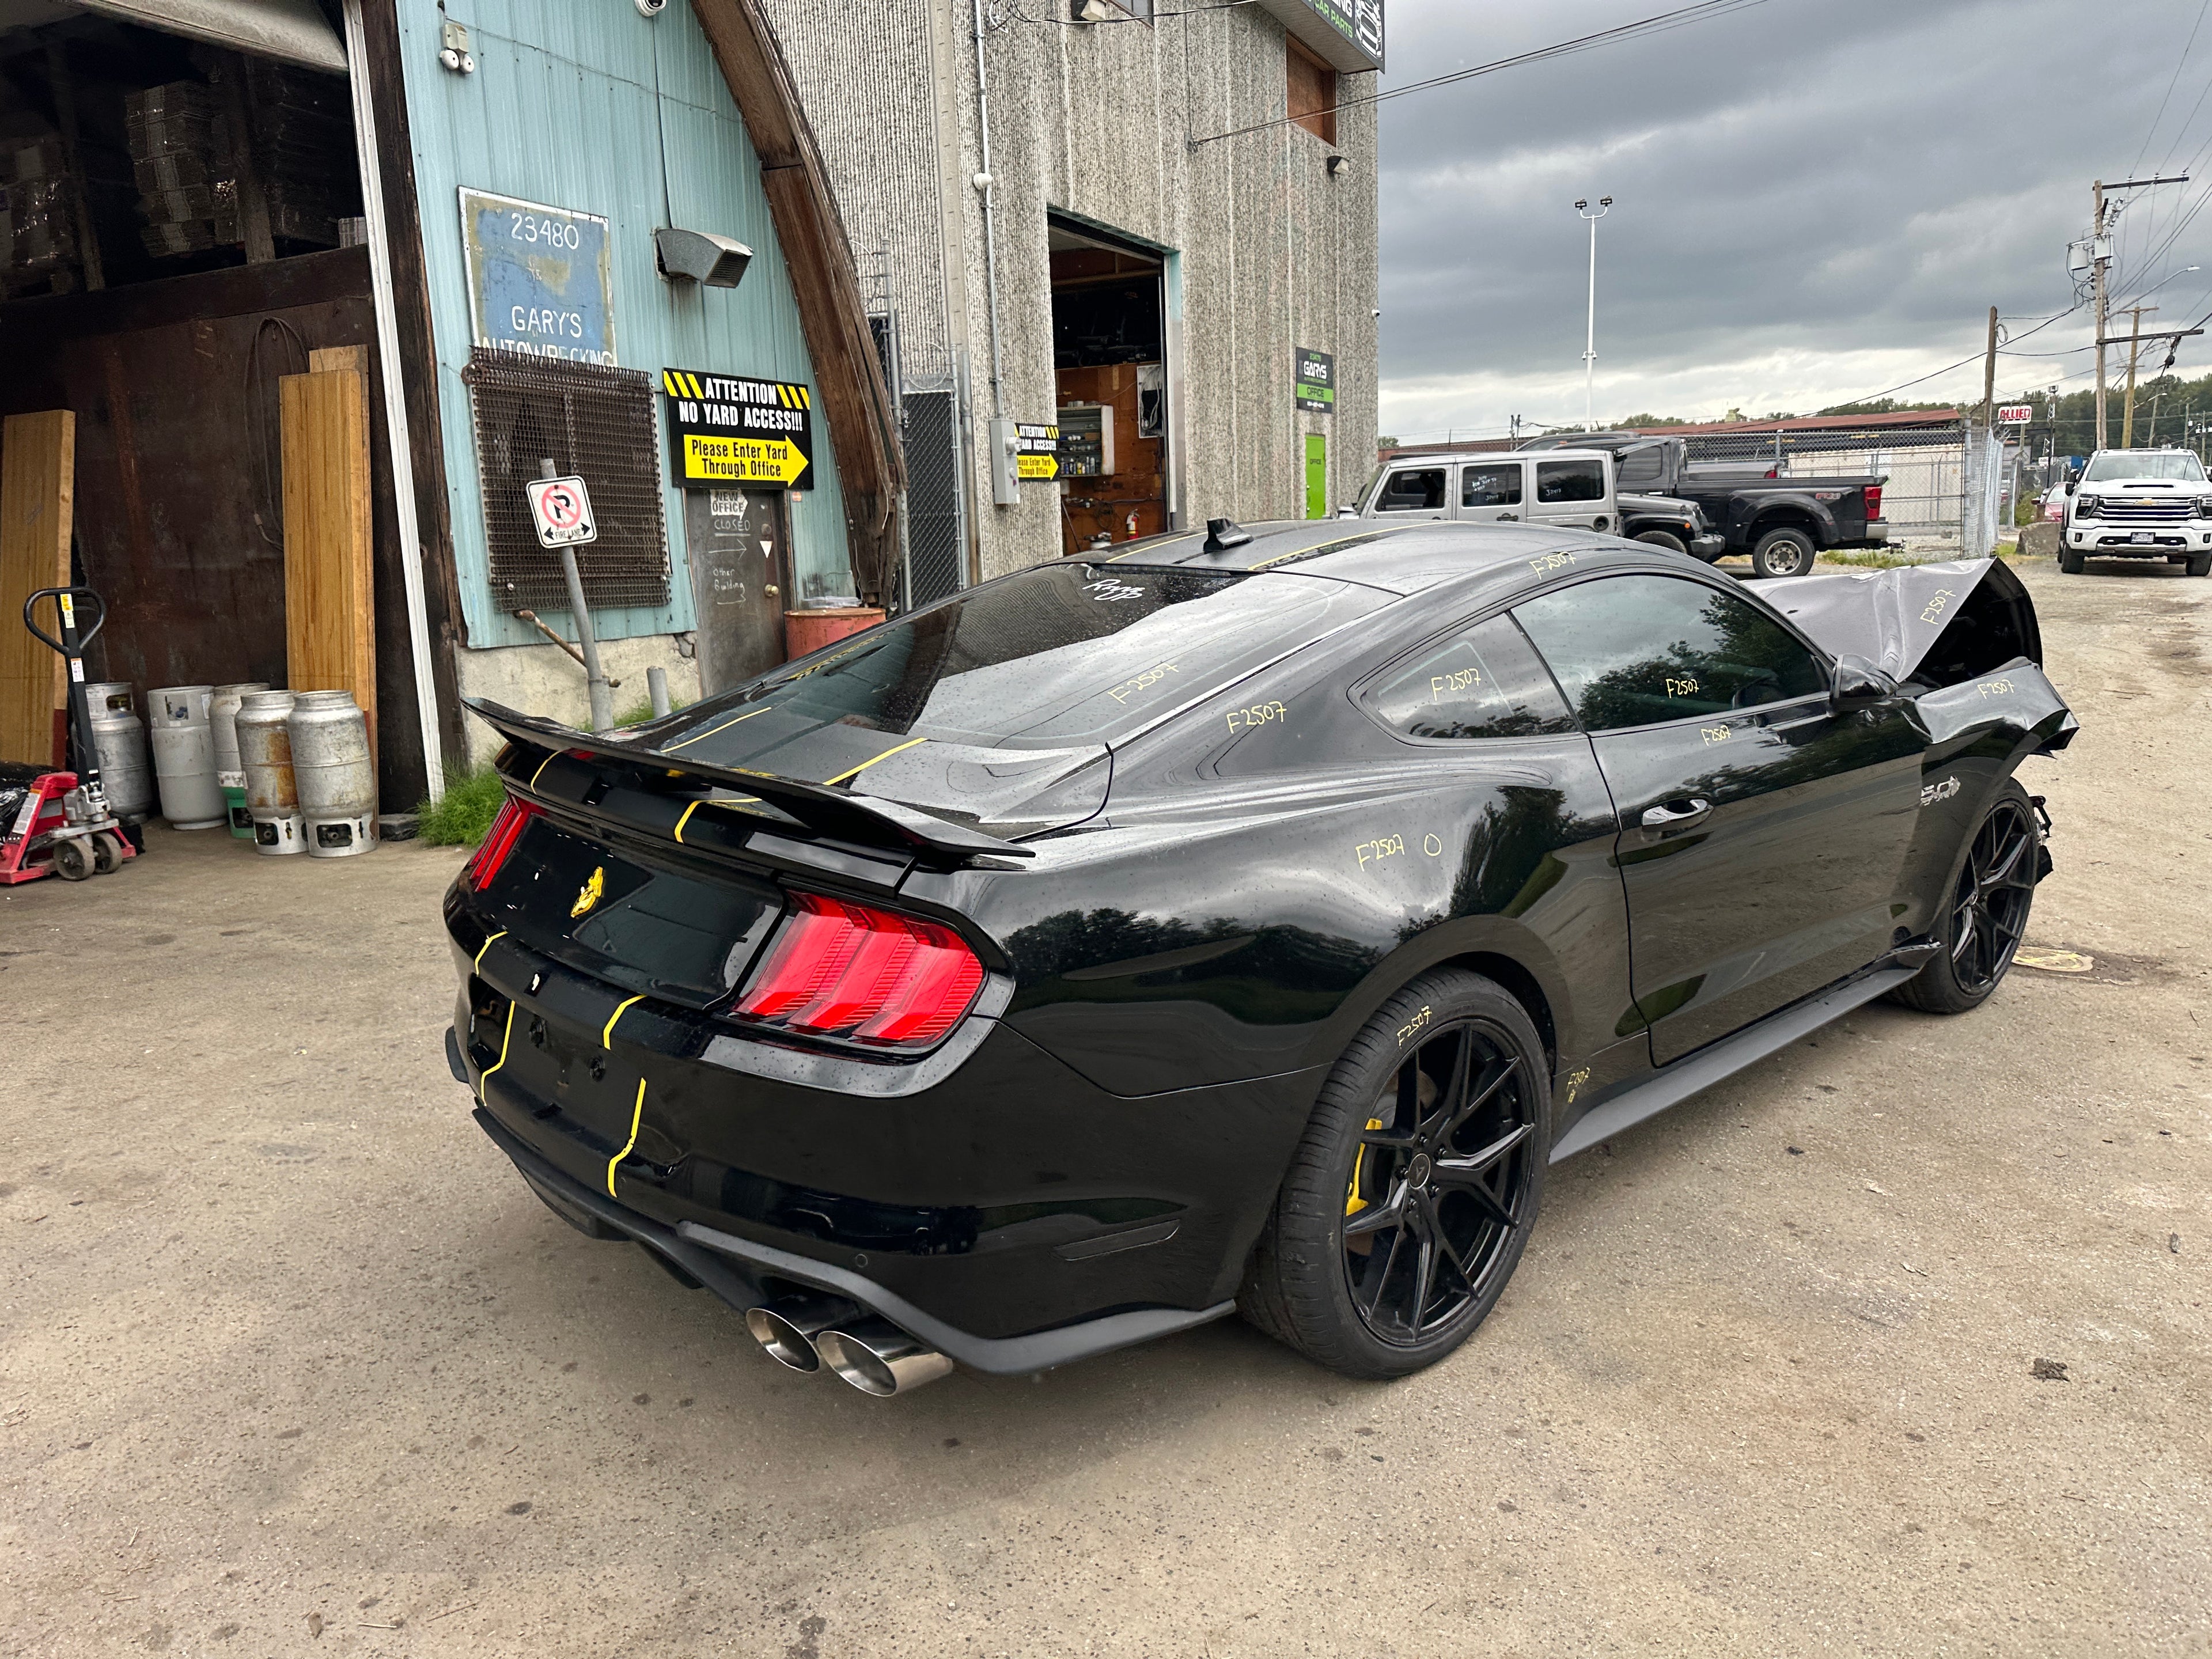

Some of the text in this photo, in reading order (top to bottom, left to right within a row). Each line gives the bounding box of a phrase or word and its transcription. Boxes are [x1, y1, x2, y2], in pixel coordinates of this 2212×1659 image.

[1315, 0, 1353, 39] CAR PARTS
[512, 213, 579, 249] 23480
[512, 306, 582, 338] GARY'S
[1304, 361, 1327, 379] GARYS
[705, 378, 777, 404] ATTENTION
[1307, 387, 1324, 397] OFFICE
[679, 401, 803, 431] NO YARD ACCESS!!!
[1999, 408, 2031, 419] ALLIED
[1019, 425, 1046, 438] ATTENTION
[692, 440, 787, 460] Please Enter Yard
[1021, 439, 1032, 450] ARD
[702, 458, 781, 478] Through Office
[1017, 457, 1050, 467] lease Enter Yard
[1018, 467, 1048, 476] Through Office
[715, 491, 738, 502] NEW
[712, 501, 744, 513] OFFICE
[555, 528, 581, 539] FIRE LANE
[714, 519, 751, 531] CLOSED
[713, 567, 735, 576] Other
[1529, 552, 1577, 579] F2507
[714, 579, 745, 594] Building
[1920, 589, 1956, 625] F2507
[1107, 662, 1179, 704] F2507
[1431, 668, 1481, 700] F2507
[1665, 679, 1699, 699] F2507
[1977, 679, 2014, 699] F2507
[1226, 701, 1287, 733] F2507
[1701, 725, 1732, 746] F2507
[1355, 834, 1405, 872] F2507
[1397, 1005, 1432, 1048] F2507
